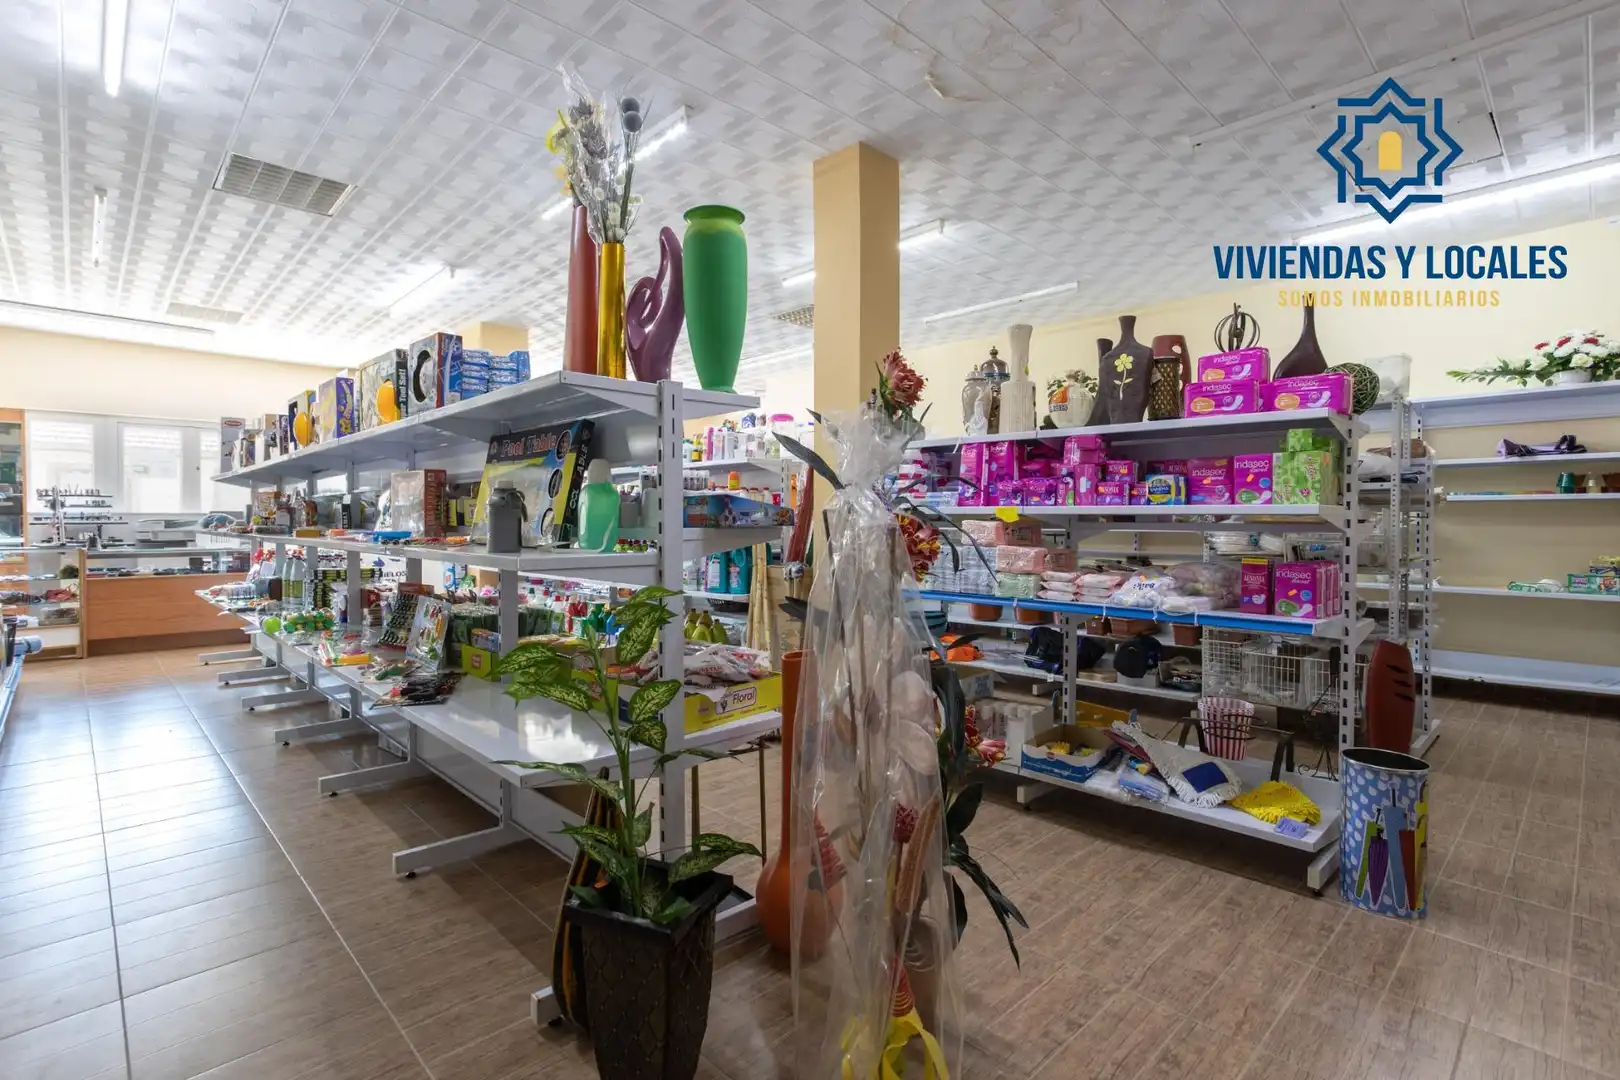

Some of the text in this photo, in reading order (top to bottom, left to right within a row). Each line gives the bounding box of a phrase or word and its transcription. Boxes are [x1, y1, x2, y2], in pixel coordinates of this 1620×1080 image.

[501, 432, 557, 457] Pool Table
[1234, 459, 1269, 469] indasec
[1192, 467, 1226, 476] indasec
[1276, 568, 1312, 580] indasec
[732, 691, 755, 704] Floral
